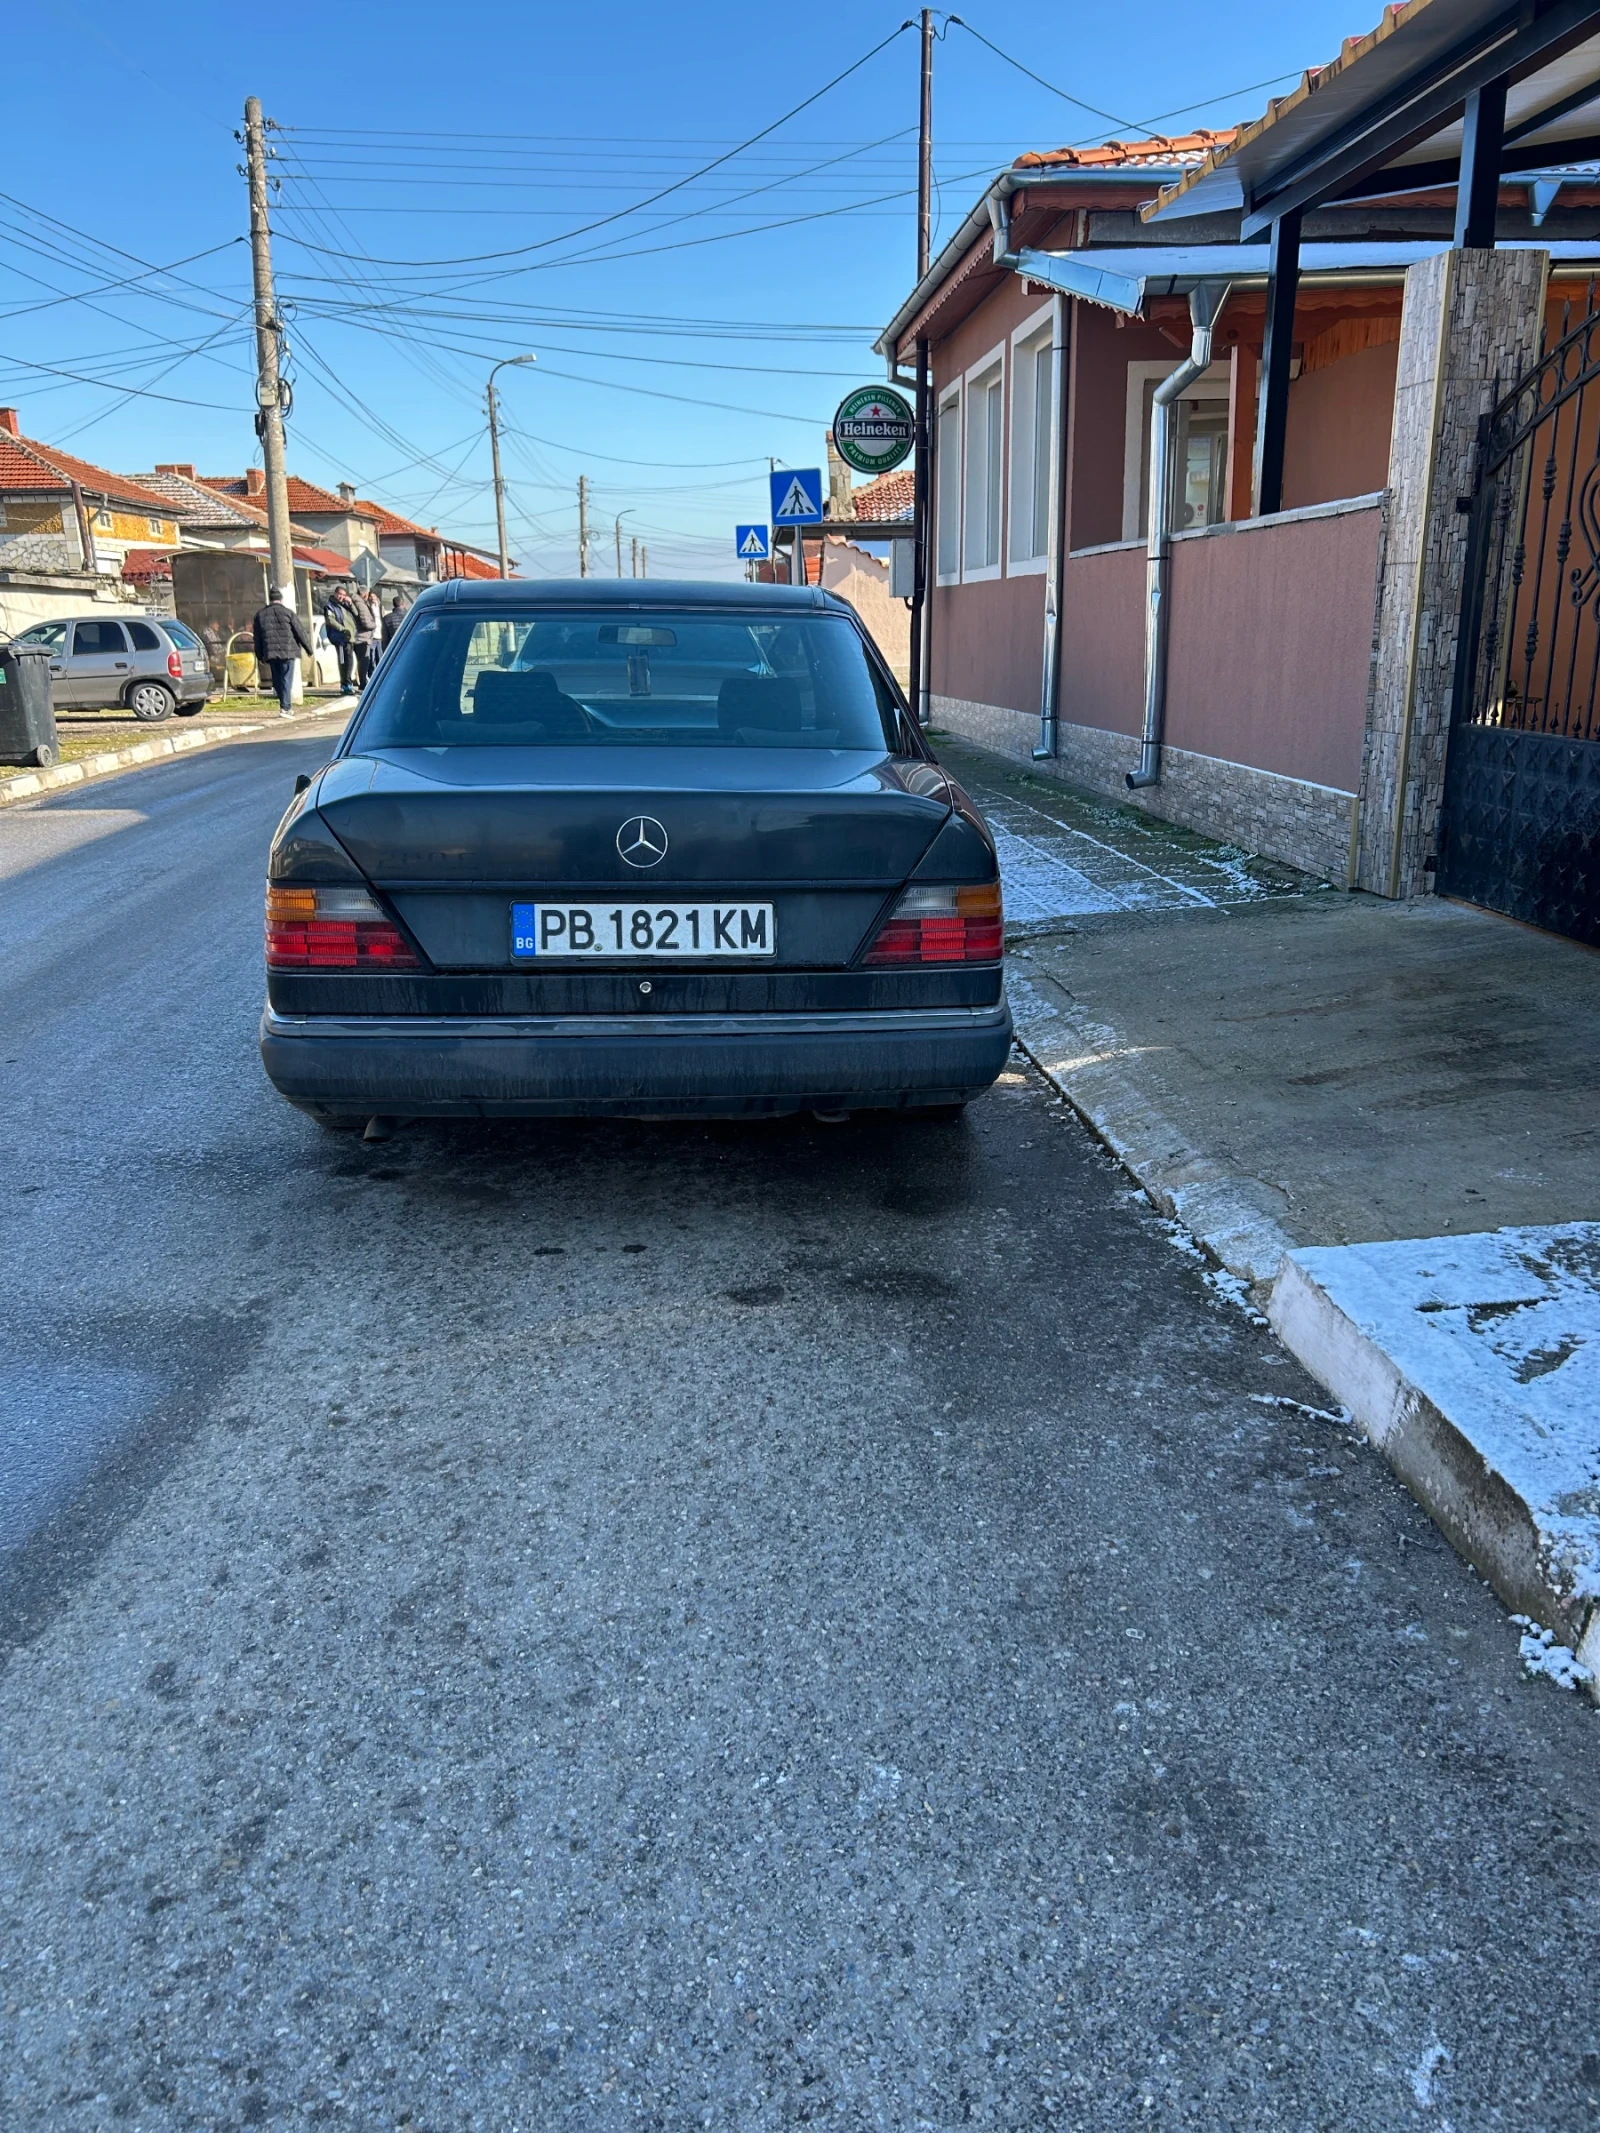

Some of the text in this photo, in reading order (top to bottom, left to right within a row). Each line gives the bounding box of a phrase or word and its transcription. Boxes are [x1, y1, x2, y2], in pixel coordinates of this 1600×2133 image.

[848, 394, 902, 413] HEINEKEN PILSENER
[843, 422, 907, 436] Heineken
[847, 445, 903, 465] PREMIUM QUALITY
[540, 909, 767, 950] PB 1821 KM
[515, 936, 534, 949] BG
